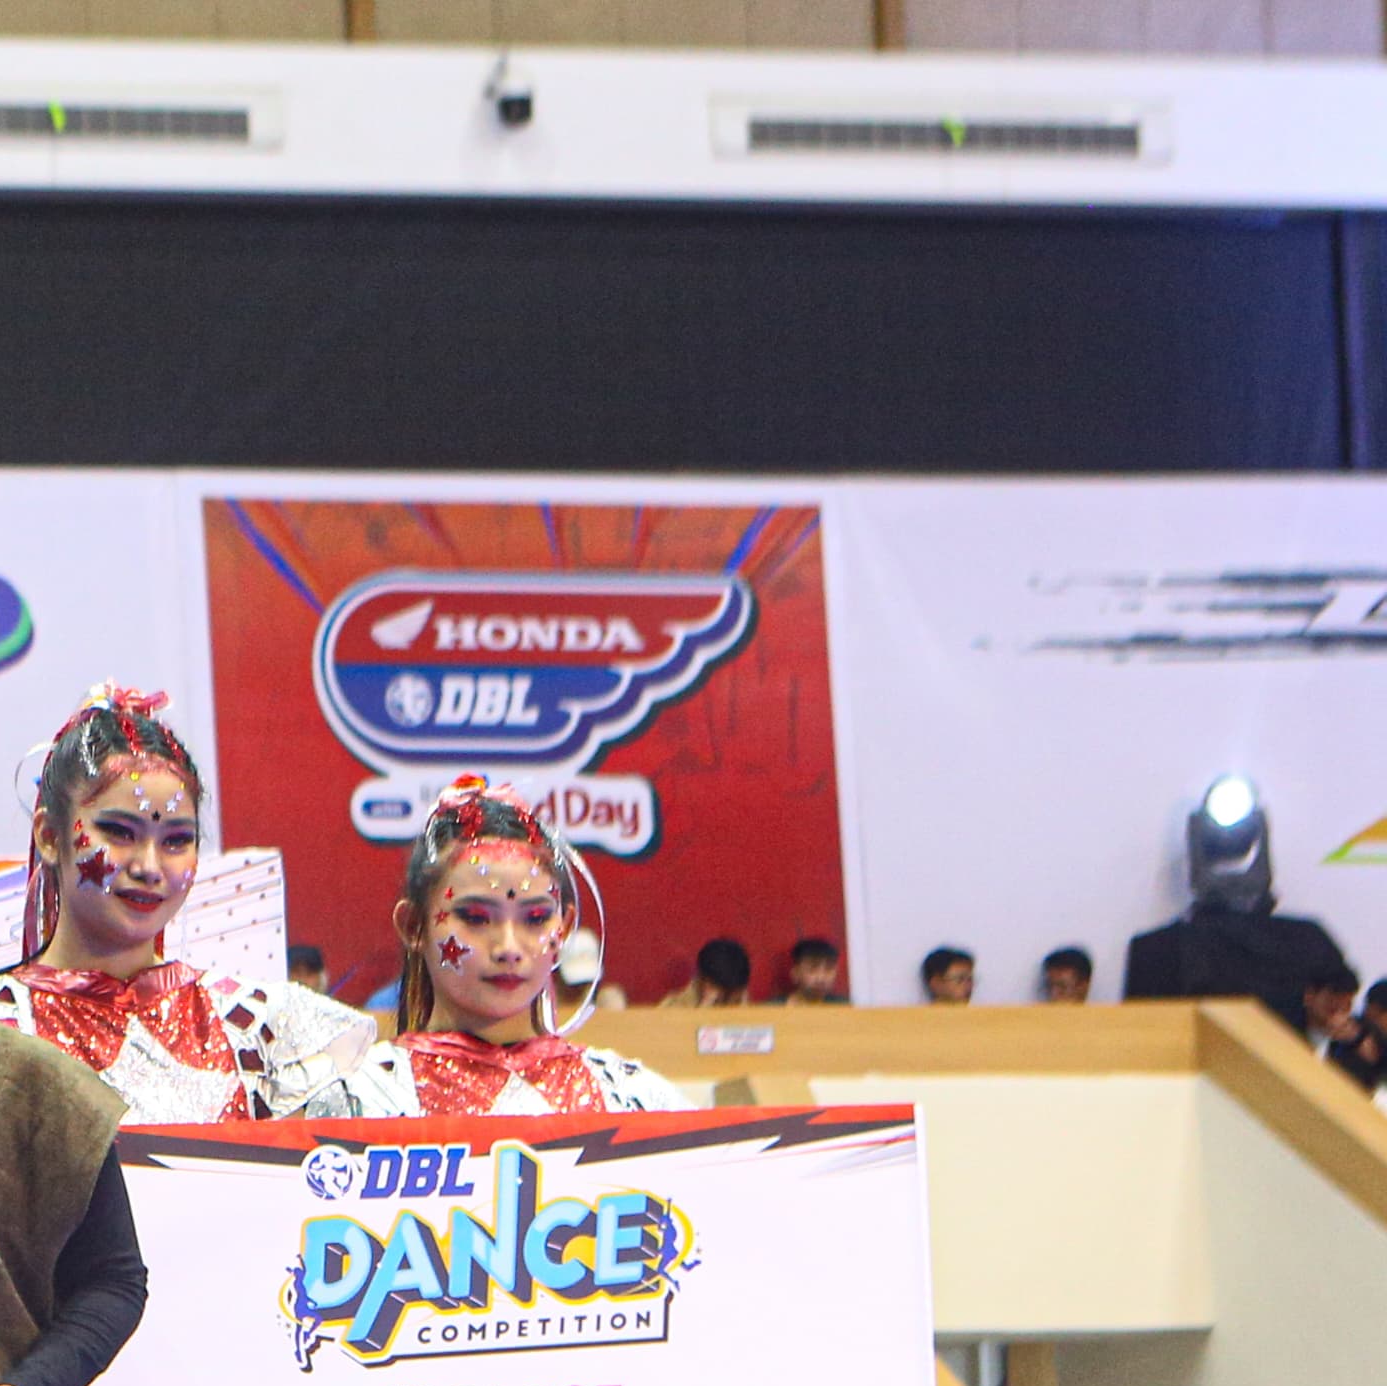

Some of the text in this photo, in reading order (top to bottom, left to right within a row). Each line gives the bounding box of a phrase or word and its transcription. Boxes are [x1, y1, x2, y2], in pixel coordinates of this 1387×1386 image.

[434, 615, 644, 653] HONDA
[434, 673, 539, 717] DBL
[564, 785, 640, 839] Day
[359, 1148, 476, 1199] DBL
[303, 1147, 661, 1350] DANCE
[416, 1310, 653, 1344] COMPETITION
